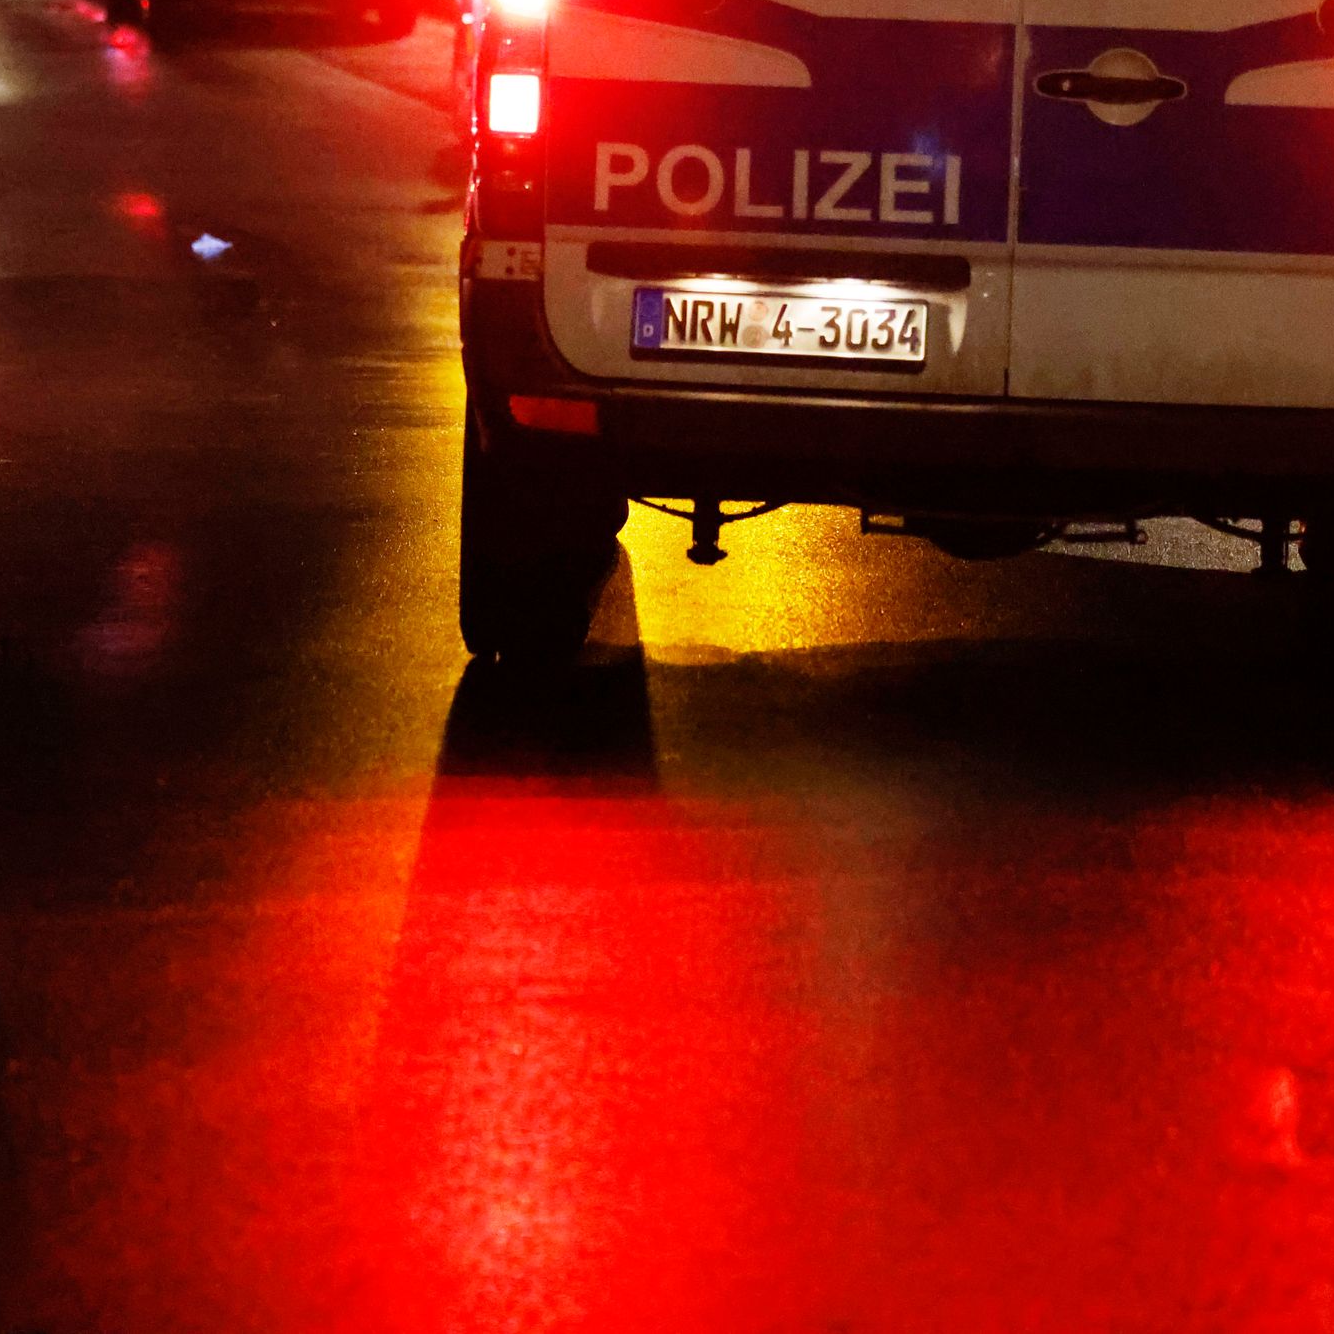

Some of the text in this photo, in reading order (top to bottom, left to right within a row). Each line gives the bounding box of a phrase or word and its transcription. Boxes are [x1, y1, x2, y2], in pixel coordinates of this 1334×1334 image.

[593, 141, 963, 226] POLIZEI
[665, 297, 923, 355] NRW 4-3034
